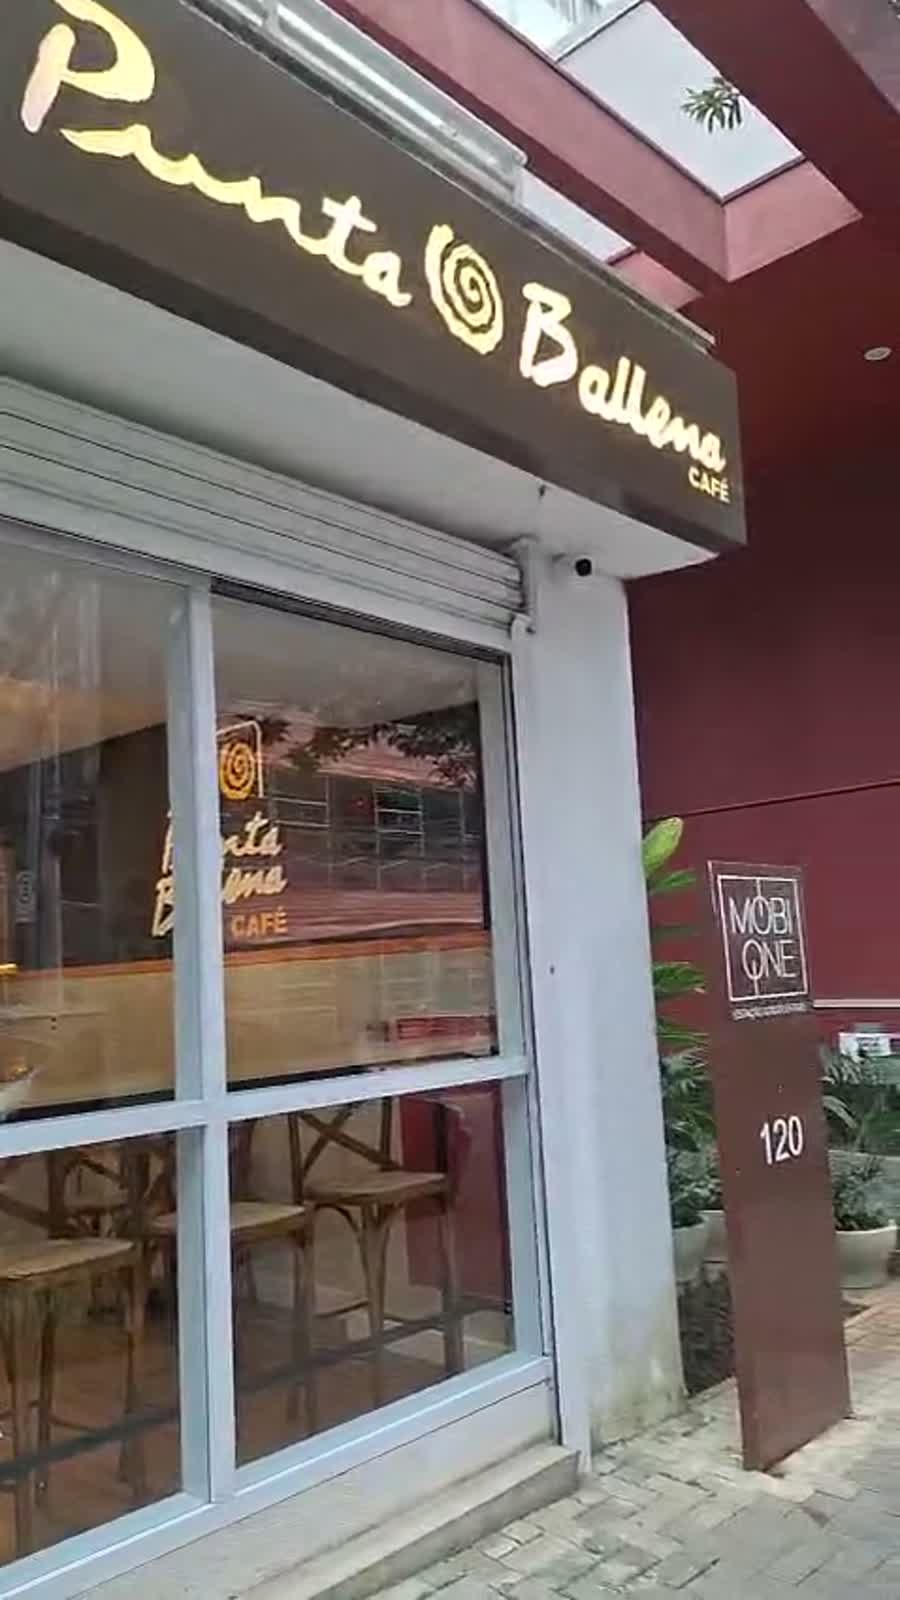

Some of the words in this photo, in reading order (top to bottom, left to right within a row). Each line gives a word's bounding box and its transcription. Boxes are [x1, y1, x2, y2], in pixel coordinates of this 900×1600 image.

[20, 0, 412, 307] Punta
[519, 282, 726, 473] Ballena
[688, 467, 731, 504] CAFÉ
[231, 906, 288, 937] CAFÉ
[728, 896, 794, 936] MOBI
[742, 939, 798, 979] ONE
[760, 1115, 803, 1165] 120
